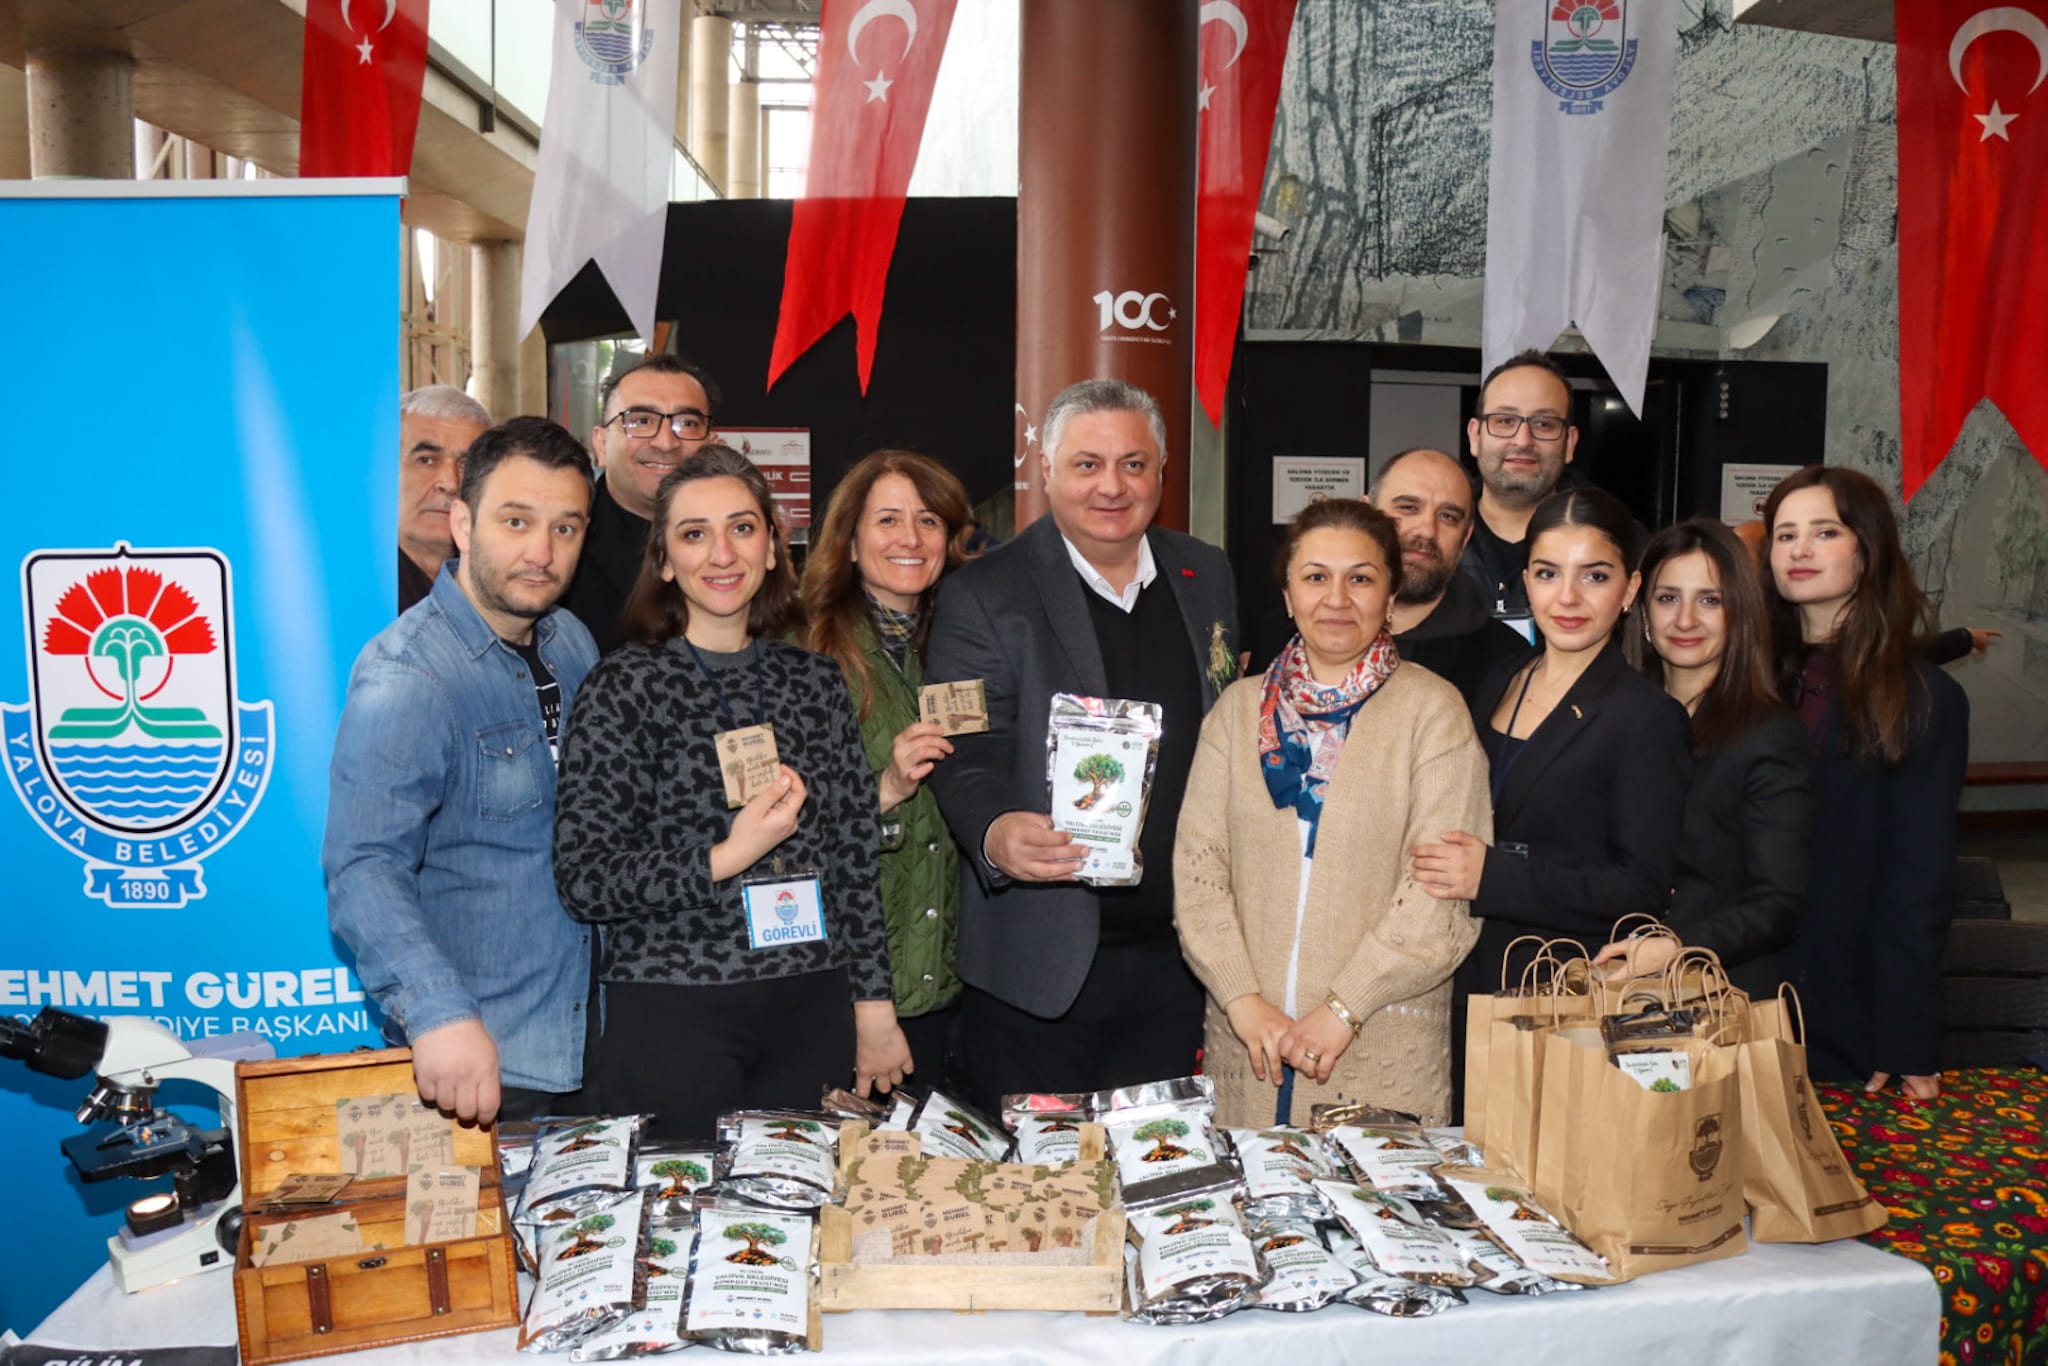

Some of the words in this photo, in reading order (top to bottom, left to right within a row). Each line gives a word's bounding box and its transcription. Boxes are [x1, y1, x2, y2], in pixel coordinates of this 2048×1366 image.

[9, 732, 88, 847] YALOVA
[115, 736, 266, 863] BELEDİYESİ
[120, 881, 170, 900] 1890
